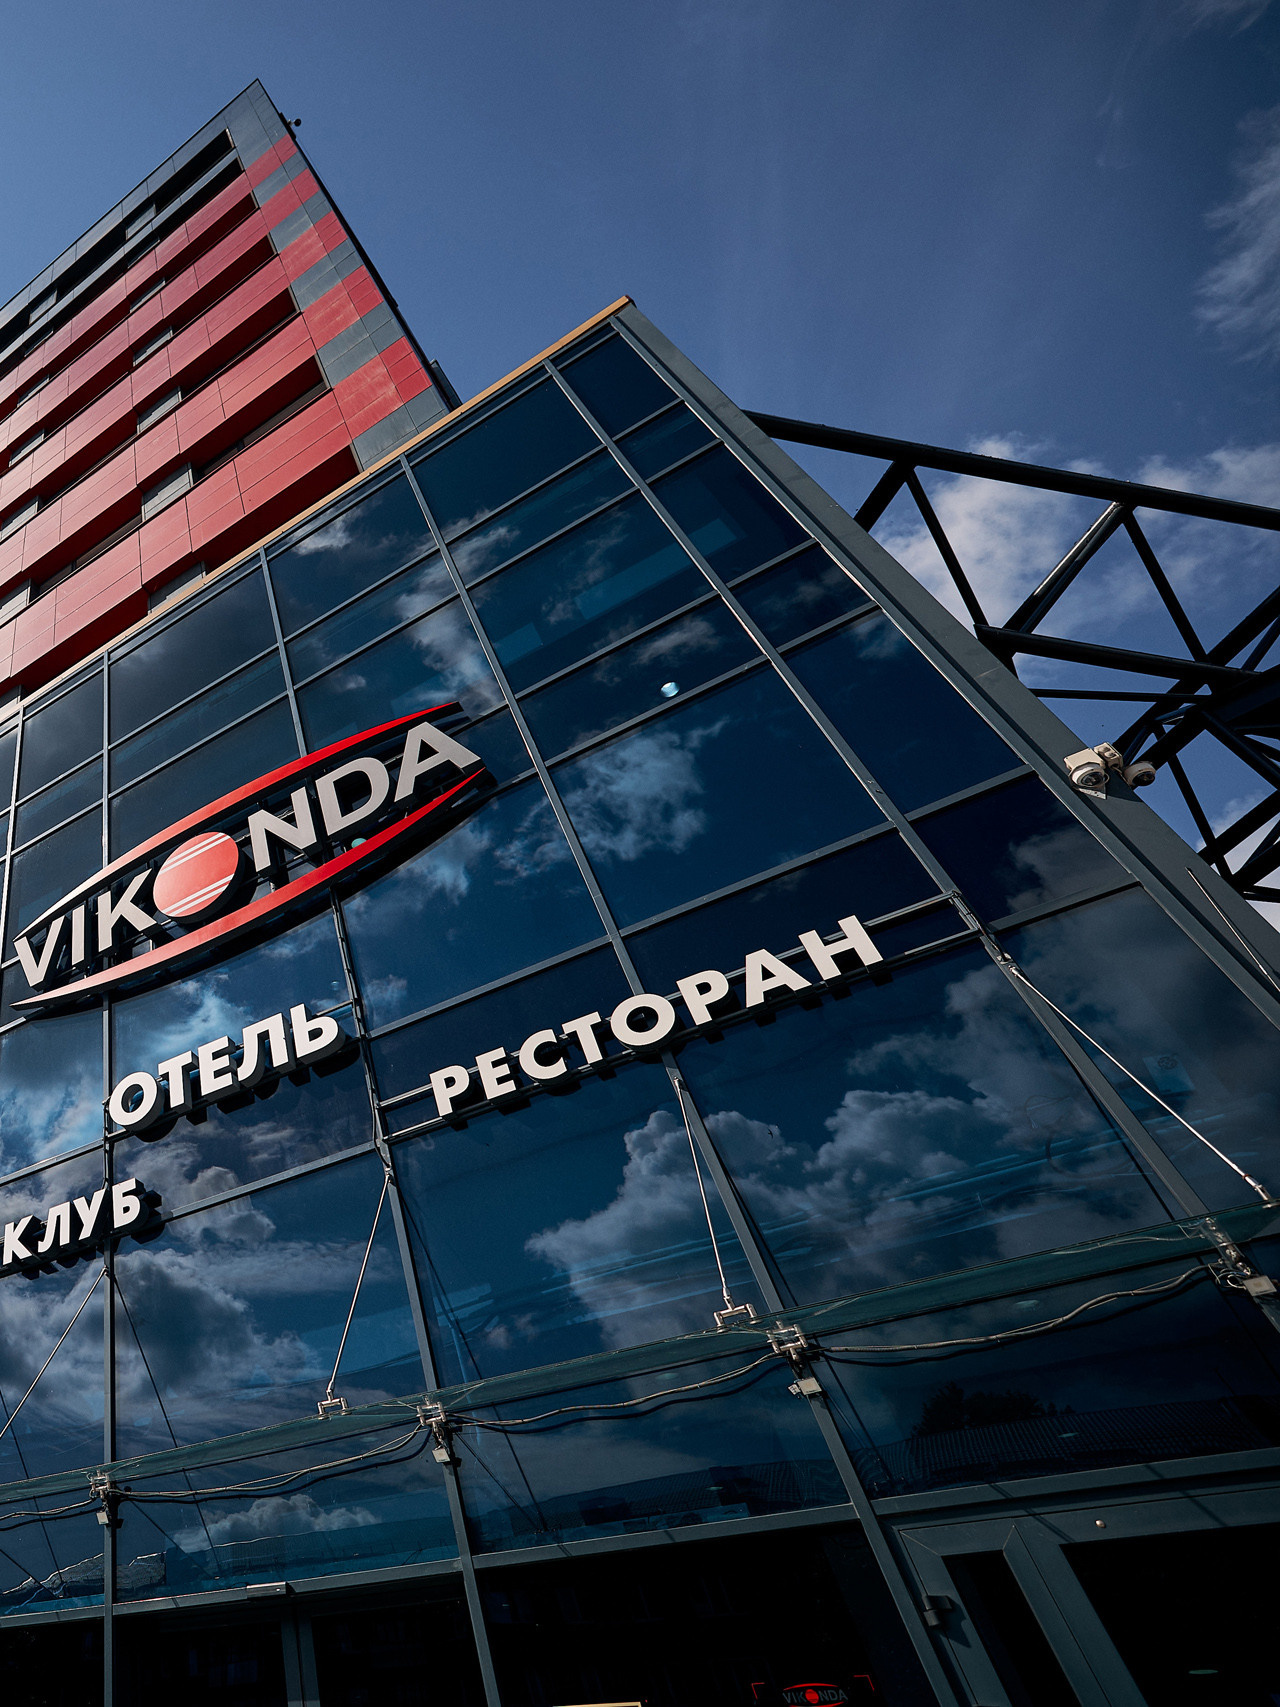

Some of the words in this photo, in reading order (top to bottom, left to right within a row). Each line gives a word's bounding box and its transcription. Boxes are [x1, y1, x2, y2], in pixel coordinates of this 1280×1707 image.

[13, 721, 482, 990] VIKONDA
[108, 1003, 340, 1127] ОТЕЛЬ
[429, 915, 884, 1117] РЕСТОРАН
[782, 1688, 849, 1704] VIKONDA
